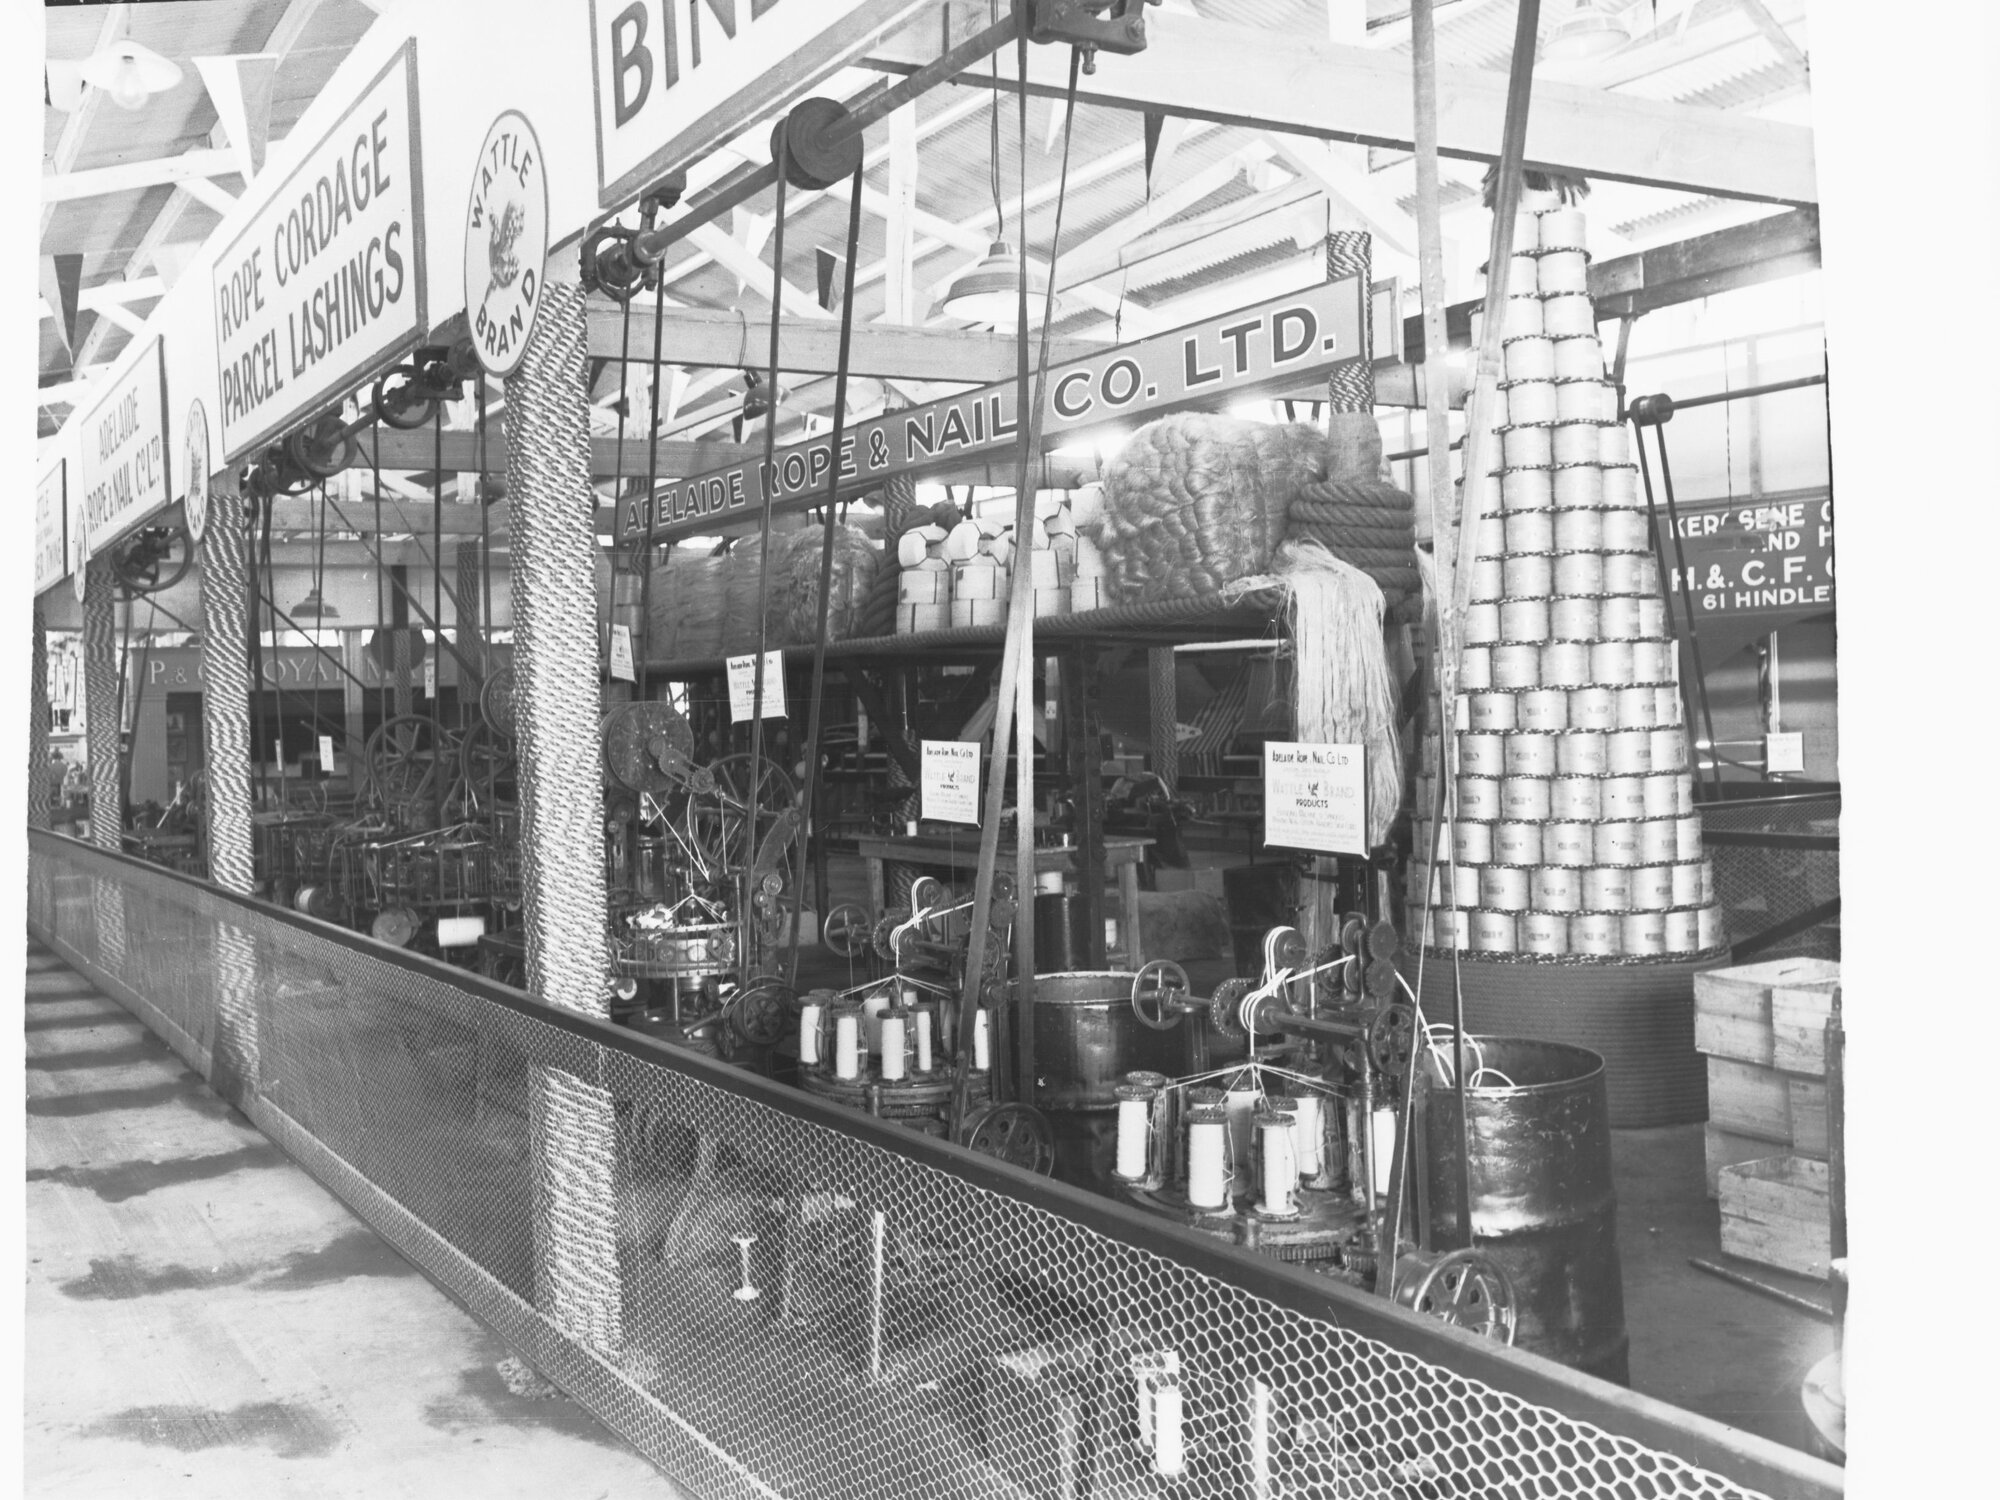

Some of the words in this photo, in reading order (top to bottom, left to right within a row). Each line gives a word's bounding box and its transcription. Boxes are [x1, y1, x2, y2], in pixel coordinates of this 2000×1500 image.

[611, 0, 779, 128] BIN
[220, 246, 265, 342] ROPE
[274, 107, 391, 287] CORDAGE
[472, 133, 532, 229] WATTLE
[222, 328, 284, 427] PARCEL
[288, 221, 404, 380] LASHINGS
[475, 268, 535, 357] BRAND
[99, 386, 140, 464] ADELAIDE
[759, 436, 857, 499] ROPE
[868, 427, 890, 470] &
[905, 392, 1019, 463] NAIL
[1053, 356, 1158, 422] CO.
[1183, 307, 1335, 390] LTD.
[87, 482, 109, 534] ROPE
[113, 461, 133, 514] NAIL
[1750, 531, 1800, 553] ND
[1703, 593, 1726, 610] 61
[1736, 585, 1833, 608] HINDLE
[1295, 798, 1329, 809] PRODUCTS
